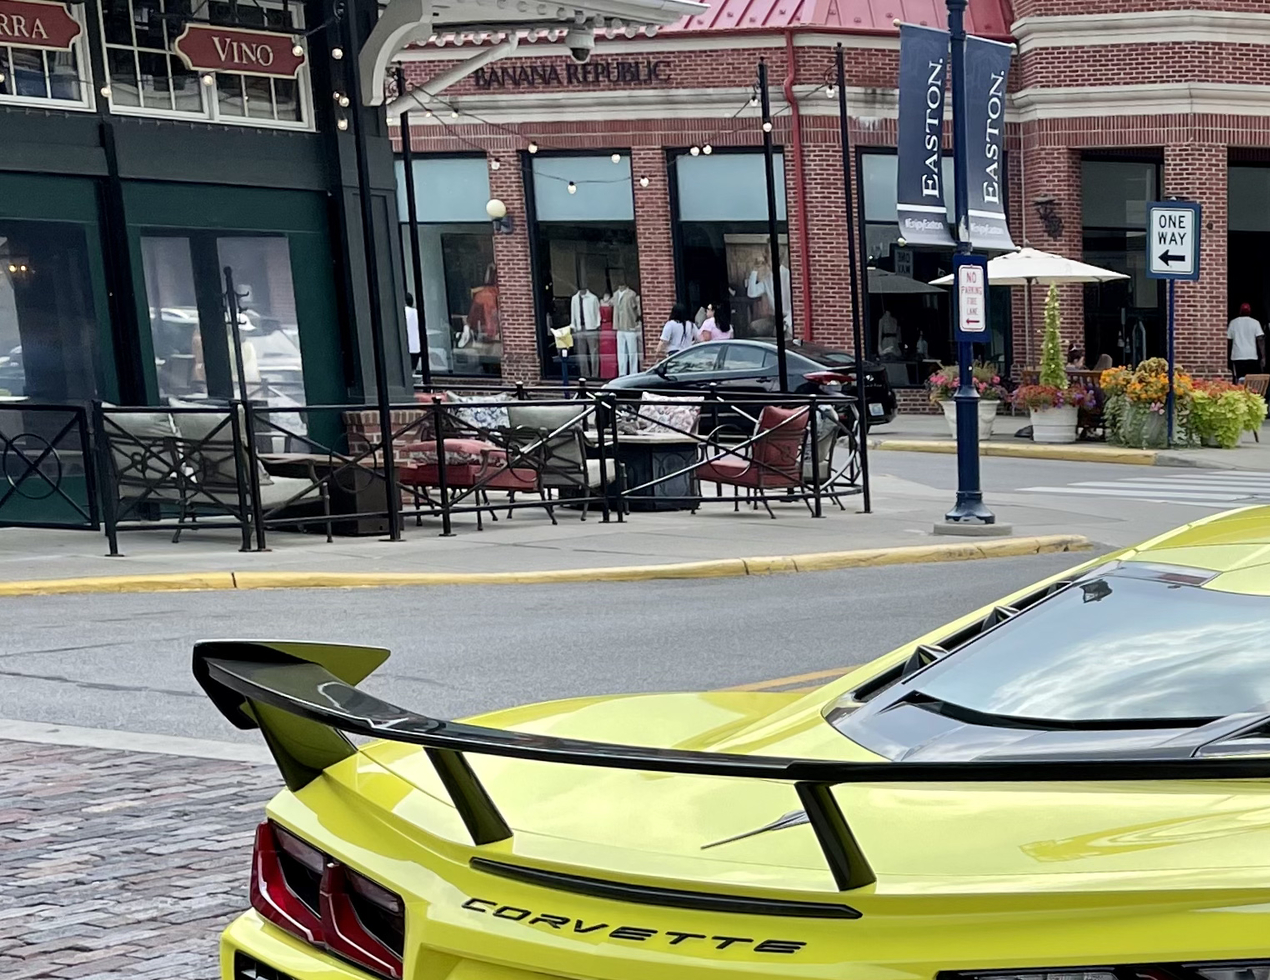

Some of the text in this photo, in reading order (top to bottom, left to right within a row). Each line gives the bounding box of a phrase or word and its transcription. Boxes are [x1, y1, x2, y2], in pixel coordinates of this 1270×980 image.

[212, 36, 274, 67] VINO
[474, 60, 671, 90] BANANA REPUBLIC
[1159, 214, 1186, 229] ONE
[1158, 231, 1187, 246] WAY
[966, 271, 977, 284] NO
[961, 285, 983, 296] PARKING
[966, 307, 979, 316] LANE
[461, 897, 808, 955] CORVETTE
